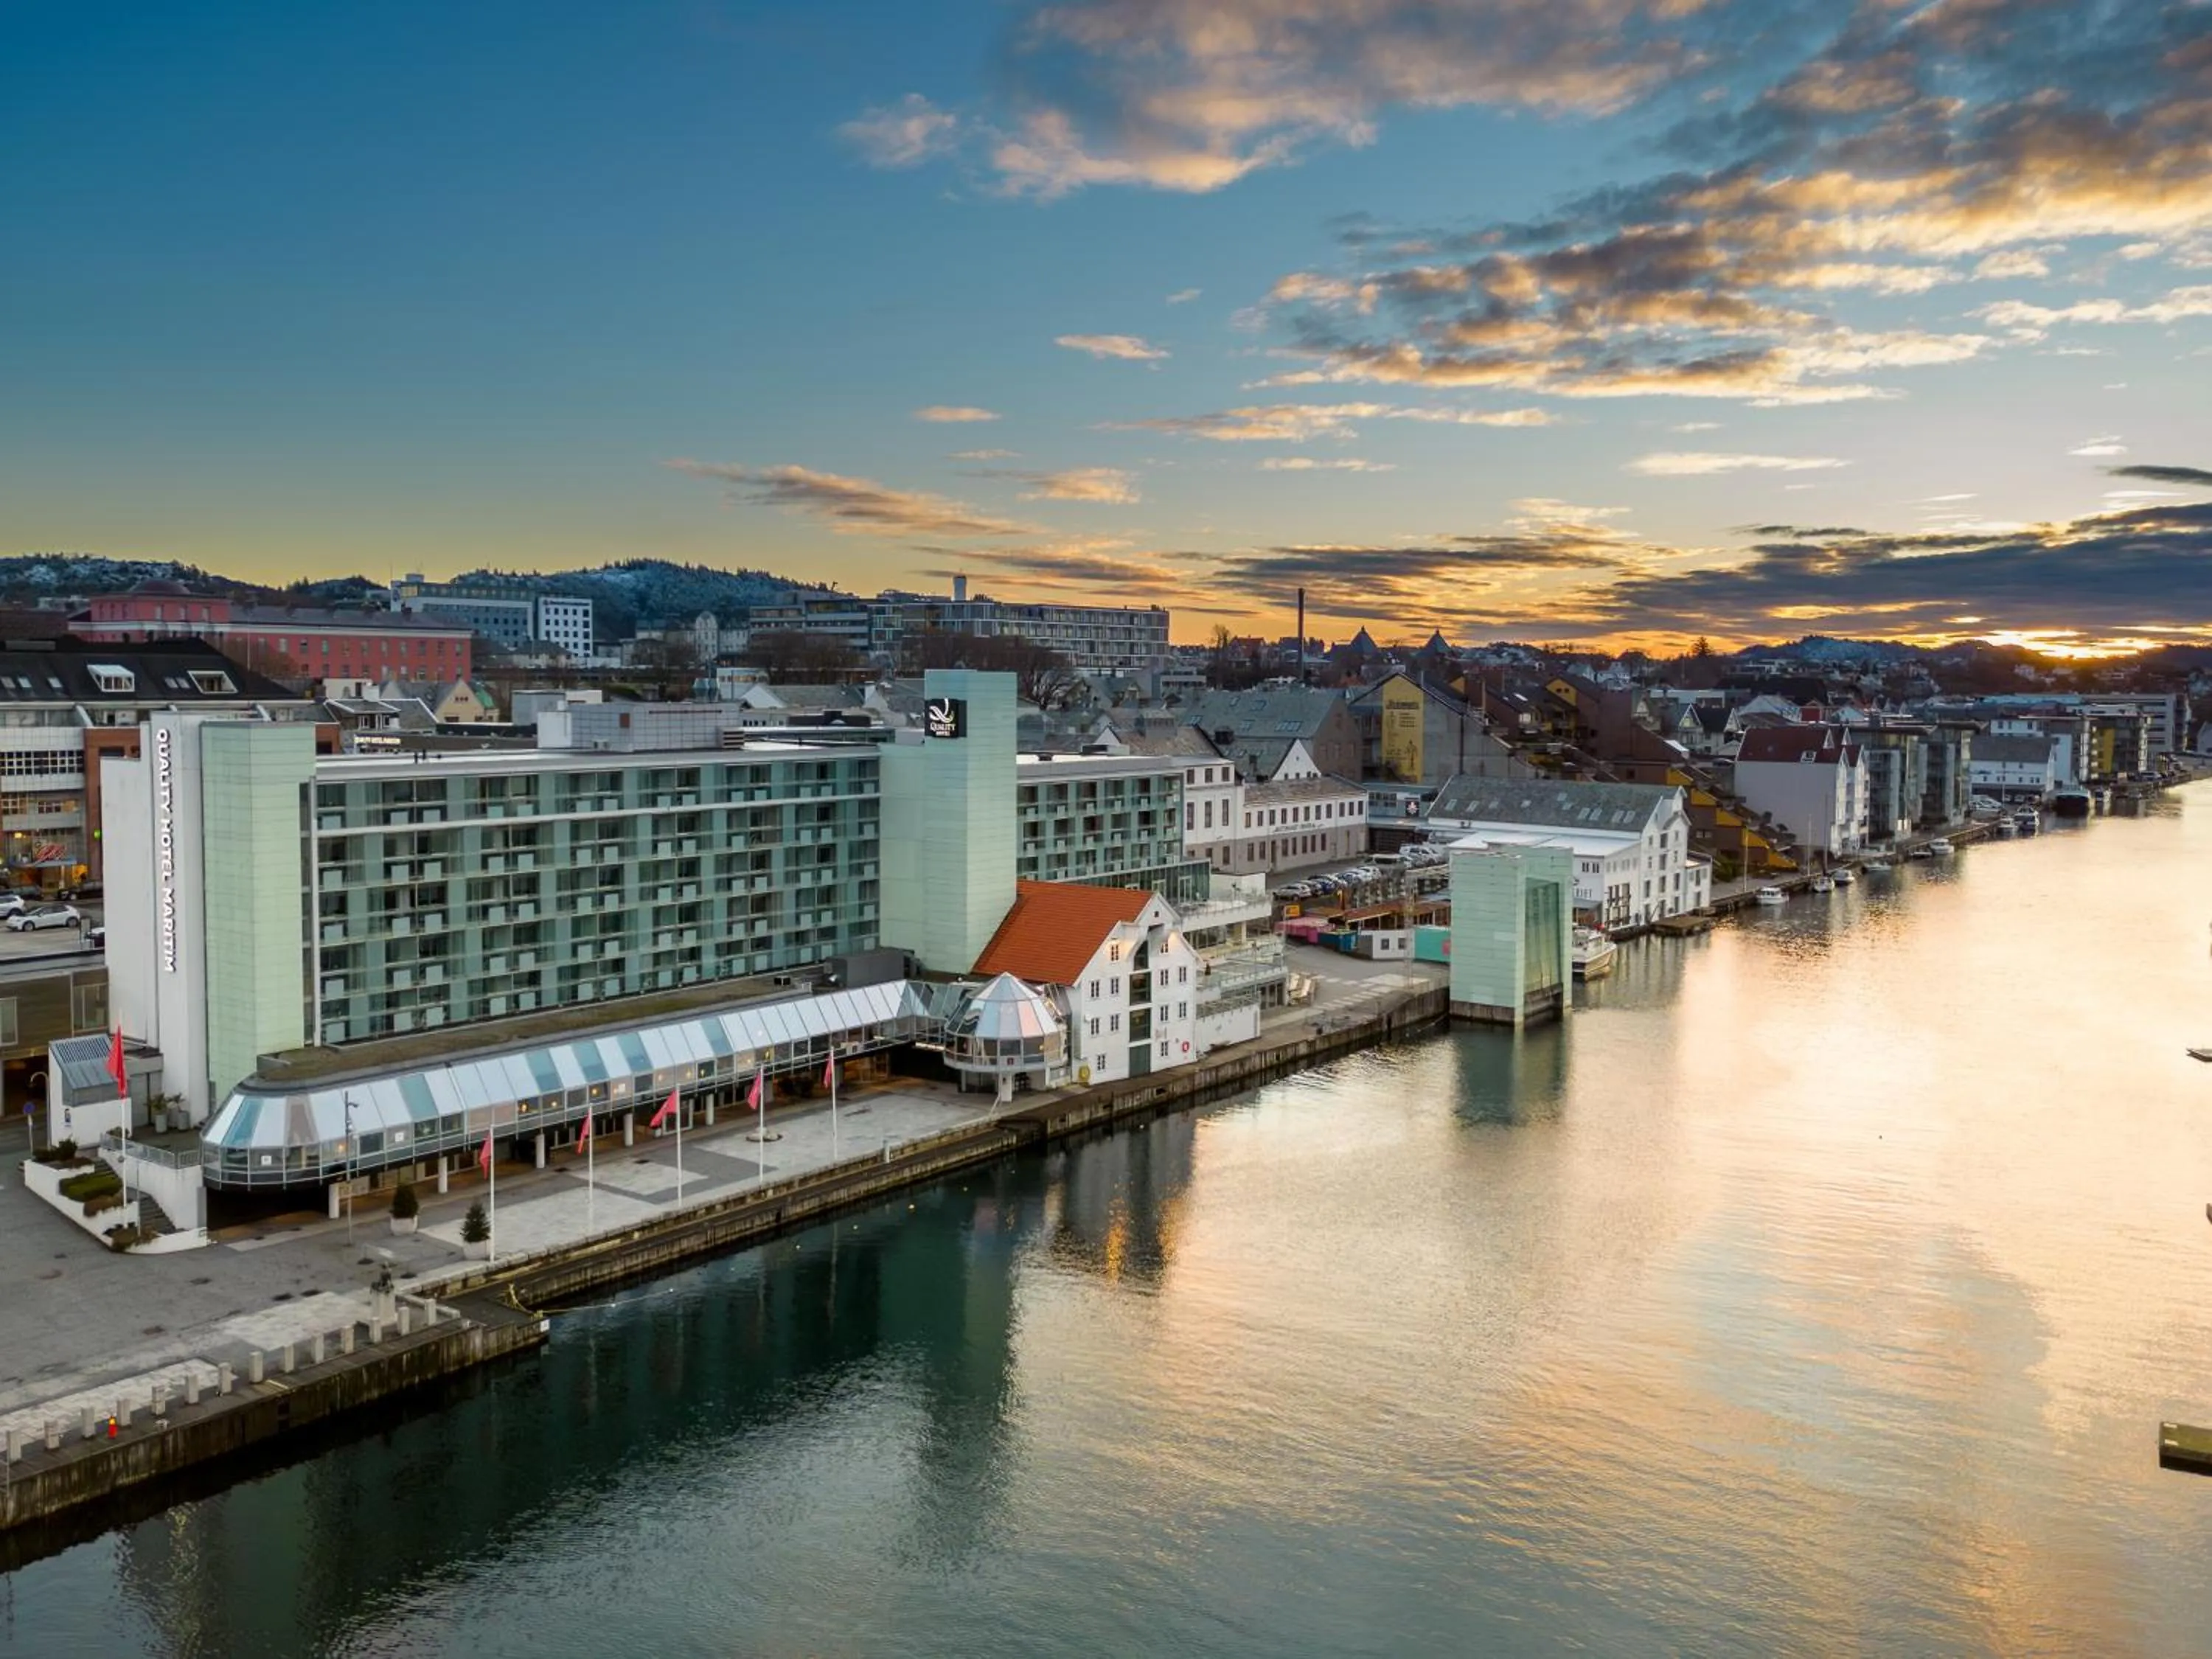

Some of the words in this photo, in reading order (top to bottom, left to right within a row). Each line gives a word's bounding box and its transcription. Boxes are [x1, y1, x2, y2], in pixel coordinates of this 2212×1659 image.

[156, 728, 171, 812] QUALITY
[161, 818, 173, 882] HOTEL
[162, 887, 175, 972] MARITIM
